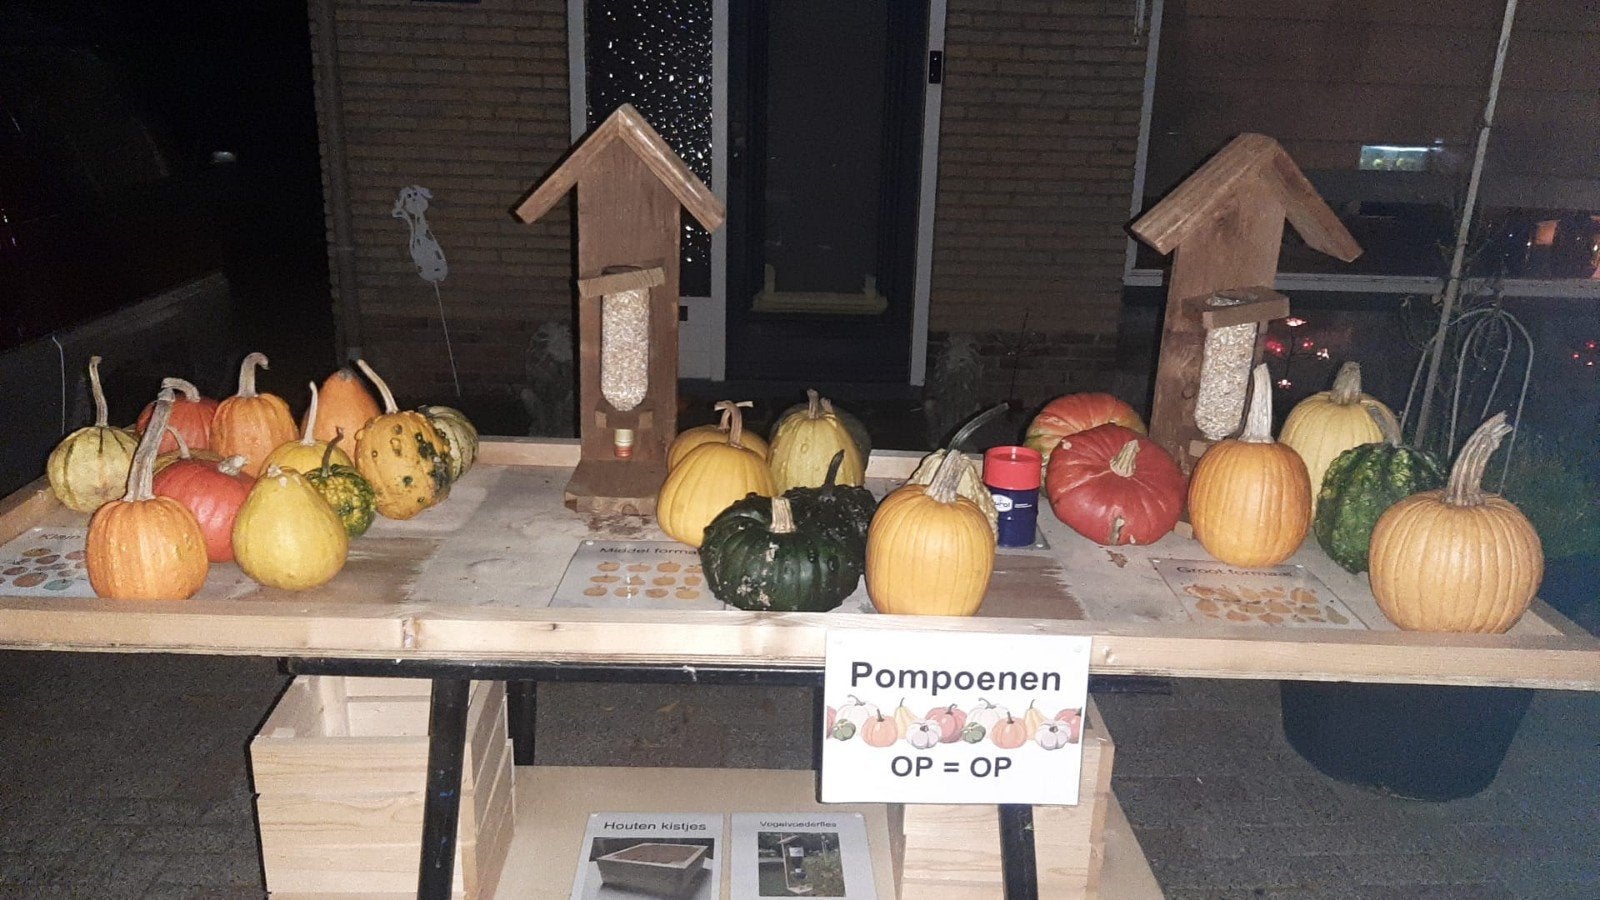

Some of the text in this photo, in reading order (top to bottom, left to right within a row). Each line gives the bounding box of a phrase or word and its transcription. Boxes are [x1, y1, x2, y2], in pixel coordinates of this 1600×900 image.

[654, 547, 698, 555] forma
[851, 661, 1061, 696] Pompoenen
[891, 756, 933, 777] OP
[970, 757, 1012, 777] OP
[604, 822, 707, 832] Houten kistjes
